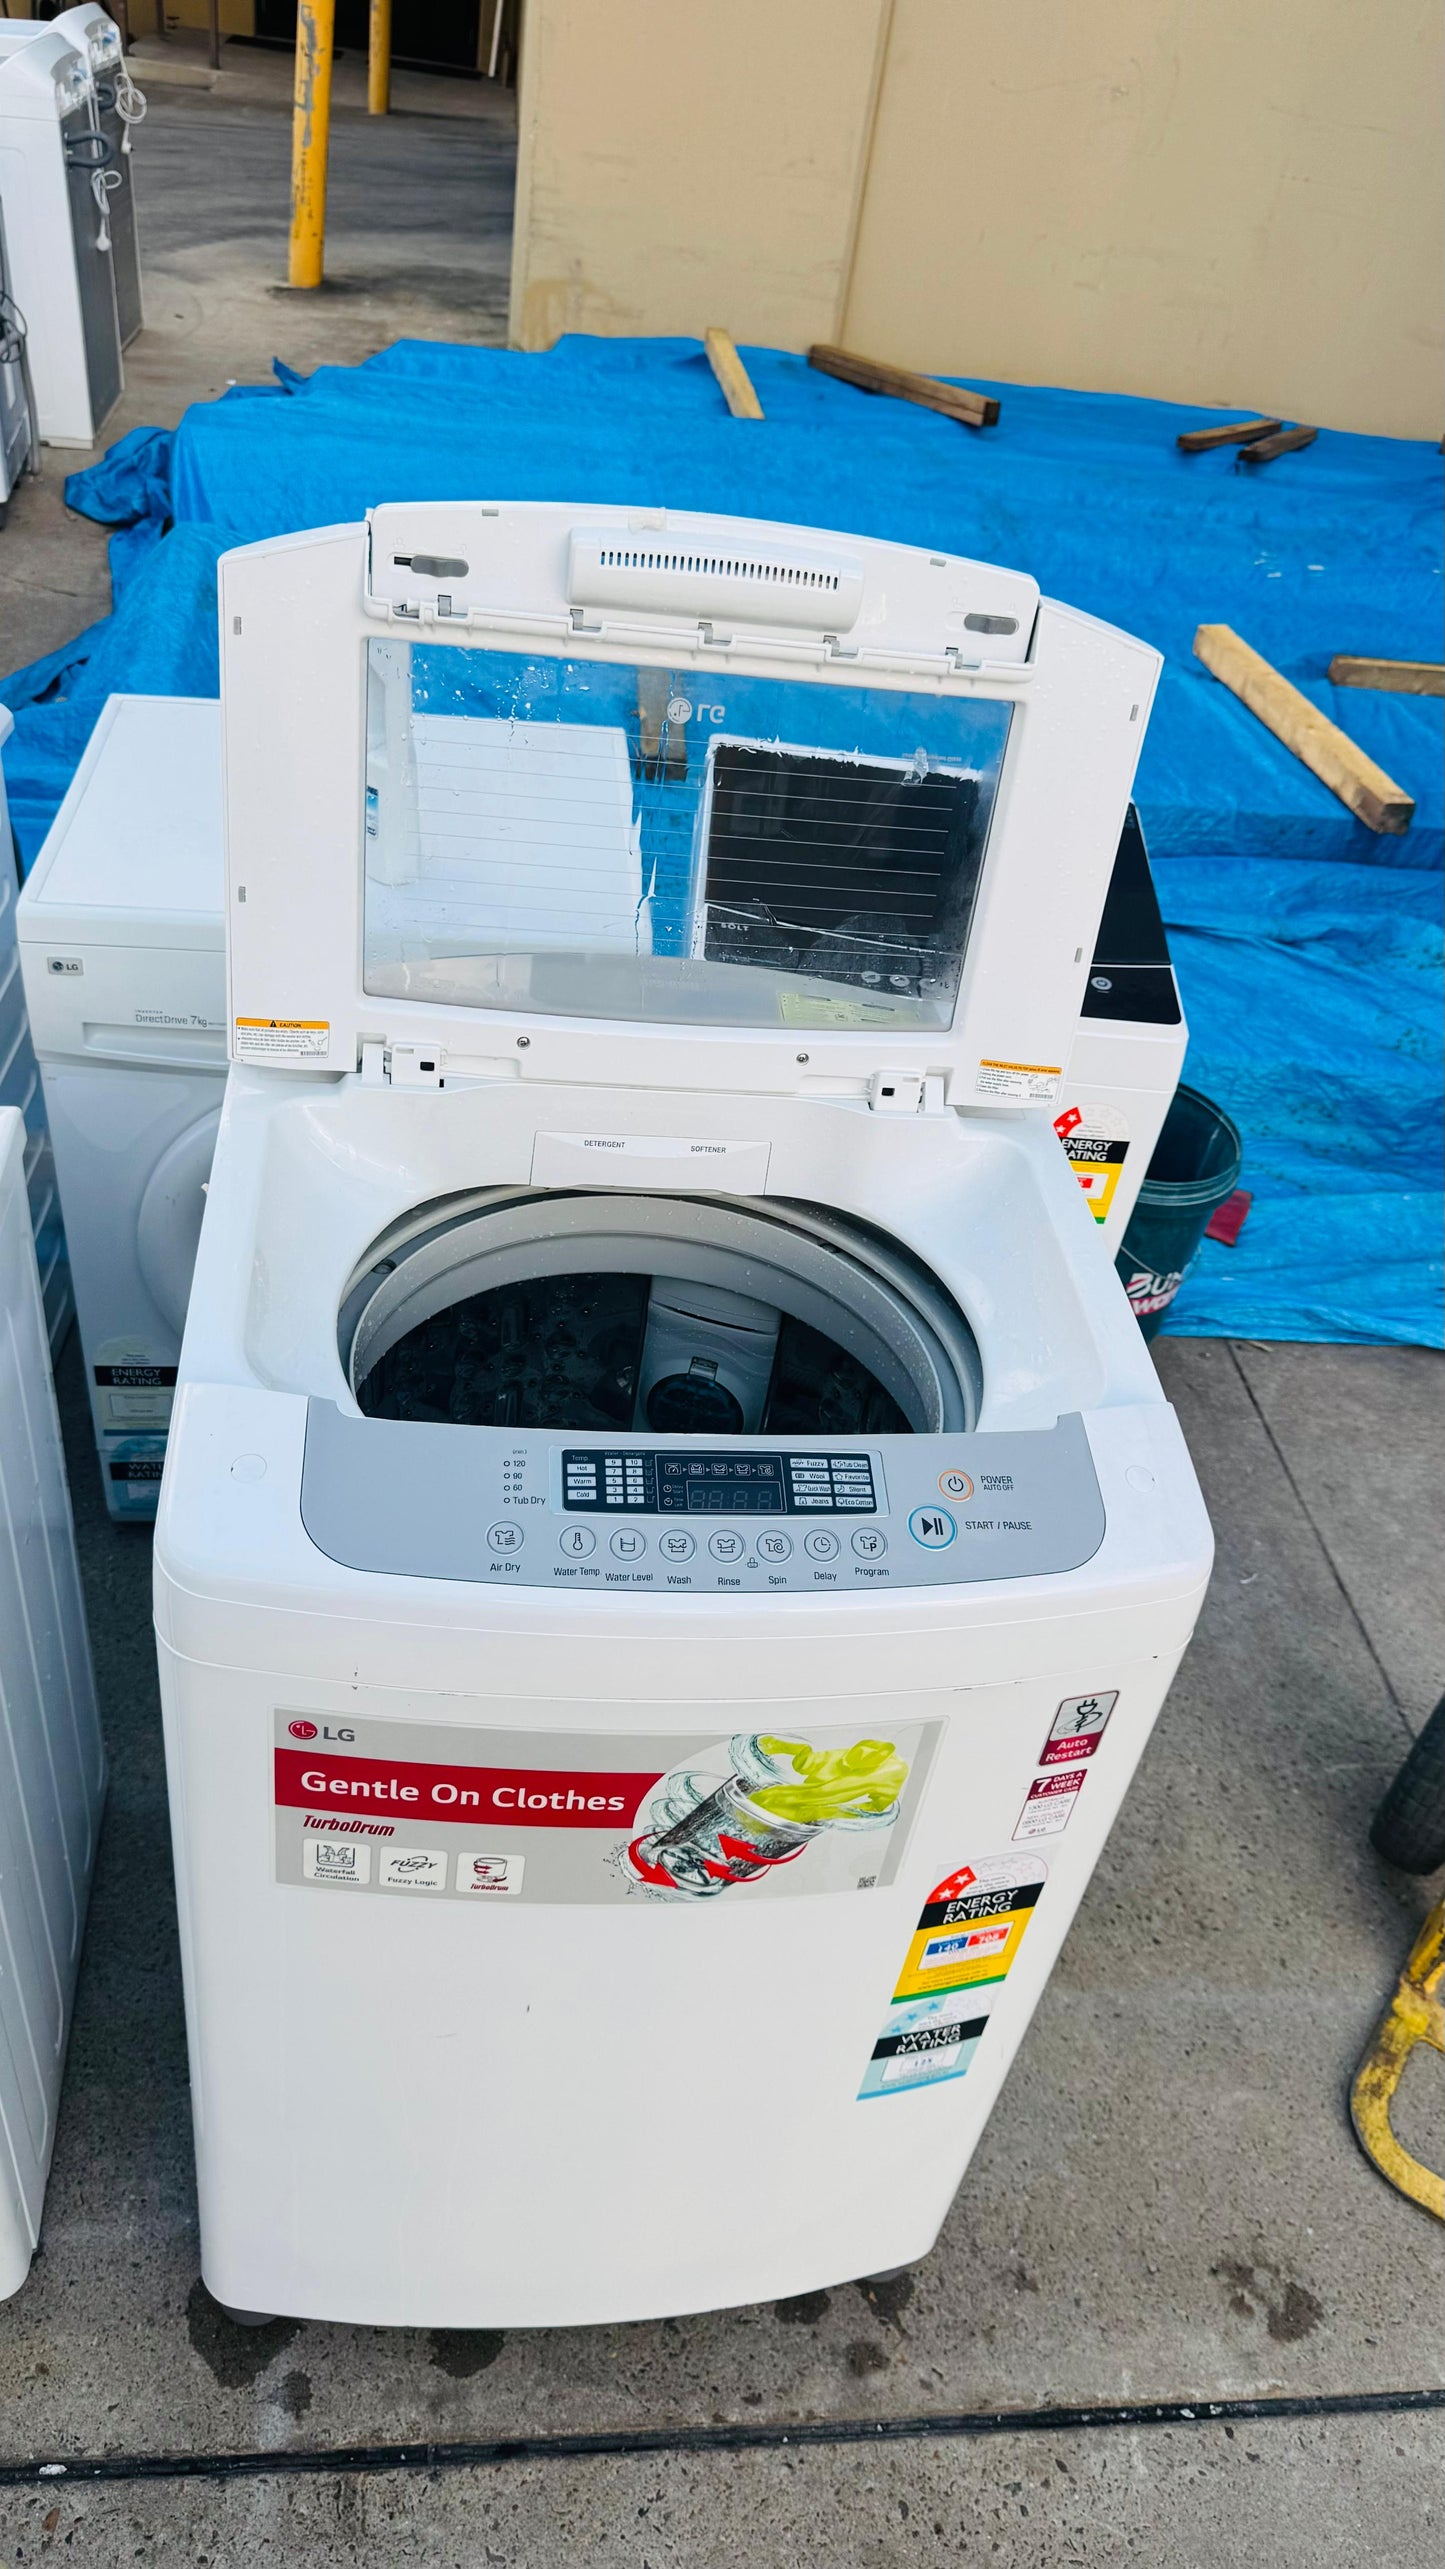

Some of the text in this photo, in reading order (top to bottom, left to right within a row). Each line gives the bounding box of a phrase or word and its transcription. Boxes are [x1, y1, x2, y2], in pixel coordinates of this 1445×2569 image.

[66, 963, 79, 971] LG
[584, 1140, 625, 1149] DETERGENT
[690, 1145, 726, 1154] SOFTENER
[1062, 1138, 1113, 1151] ENERGY
[1066, 1149, 1108, 1162] ATING
[111, 1368, 161, 1377] ENERGY
[112, 1377, 162, 1385] RATING
[513, 1472, 522, 1480] 90
[980, 1475, 1014, 1484] POWER
[513, 1496, 546, 1506] Tub Dry
[965, 1520, 994, 1530] START
[1003, 1521, 1033, 1531] PAUSE
[490, 1562, 521, 1573] Air Dry
[553, 1566, 600, 1577] Water Temp
[855, 1566, 890, 1578] Program
[605, 1572, 654, 1582] Water Level
[667, 1574, 692, 1585] Wash
[717, 1576, 741, 1586] Rinse
[768, 1575, 787, 1586] Spin
[814, 1571, 837, 1582] Delay
[323, 1726, 355, 1743] LG
[1056, 1738, 1088, 1750] Auto
[1045, 1746, 1093, 1762] Restart
[1036, 1777, 1053, 1793] 7
[1053, 1772, 1076, 1783] DAYS
[1050, 1778, 1081, 1790] WEEK
[300, 1771, 626, 1812] Gentle On Clothes
[1030, 1785, 1079, 1799] CUSTOMER CARE
[302, 1814, 396, 1837] TurboDrum
[315, 1865, 356, 1876] Waterfall
[313, 1872, 360, 1882] Circulation
[387, 1876, 438, 1887] Fuzzy Logic
[469, 1882, 509, 1892] TurboDrum
[946, 1889, 1019, 1914] ENERGY
[942, 1902, 1012, 1924] RATING
[901, 2024, 961, 2044] WATER
[896, 2034, 961, 2054] RATING
